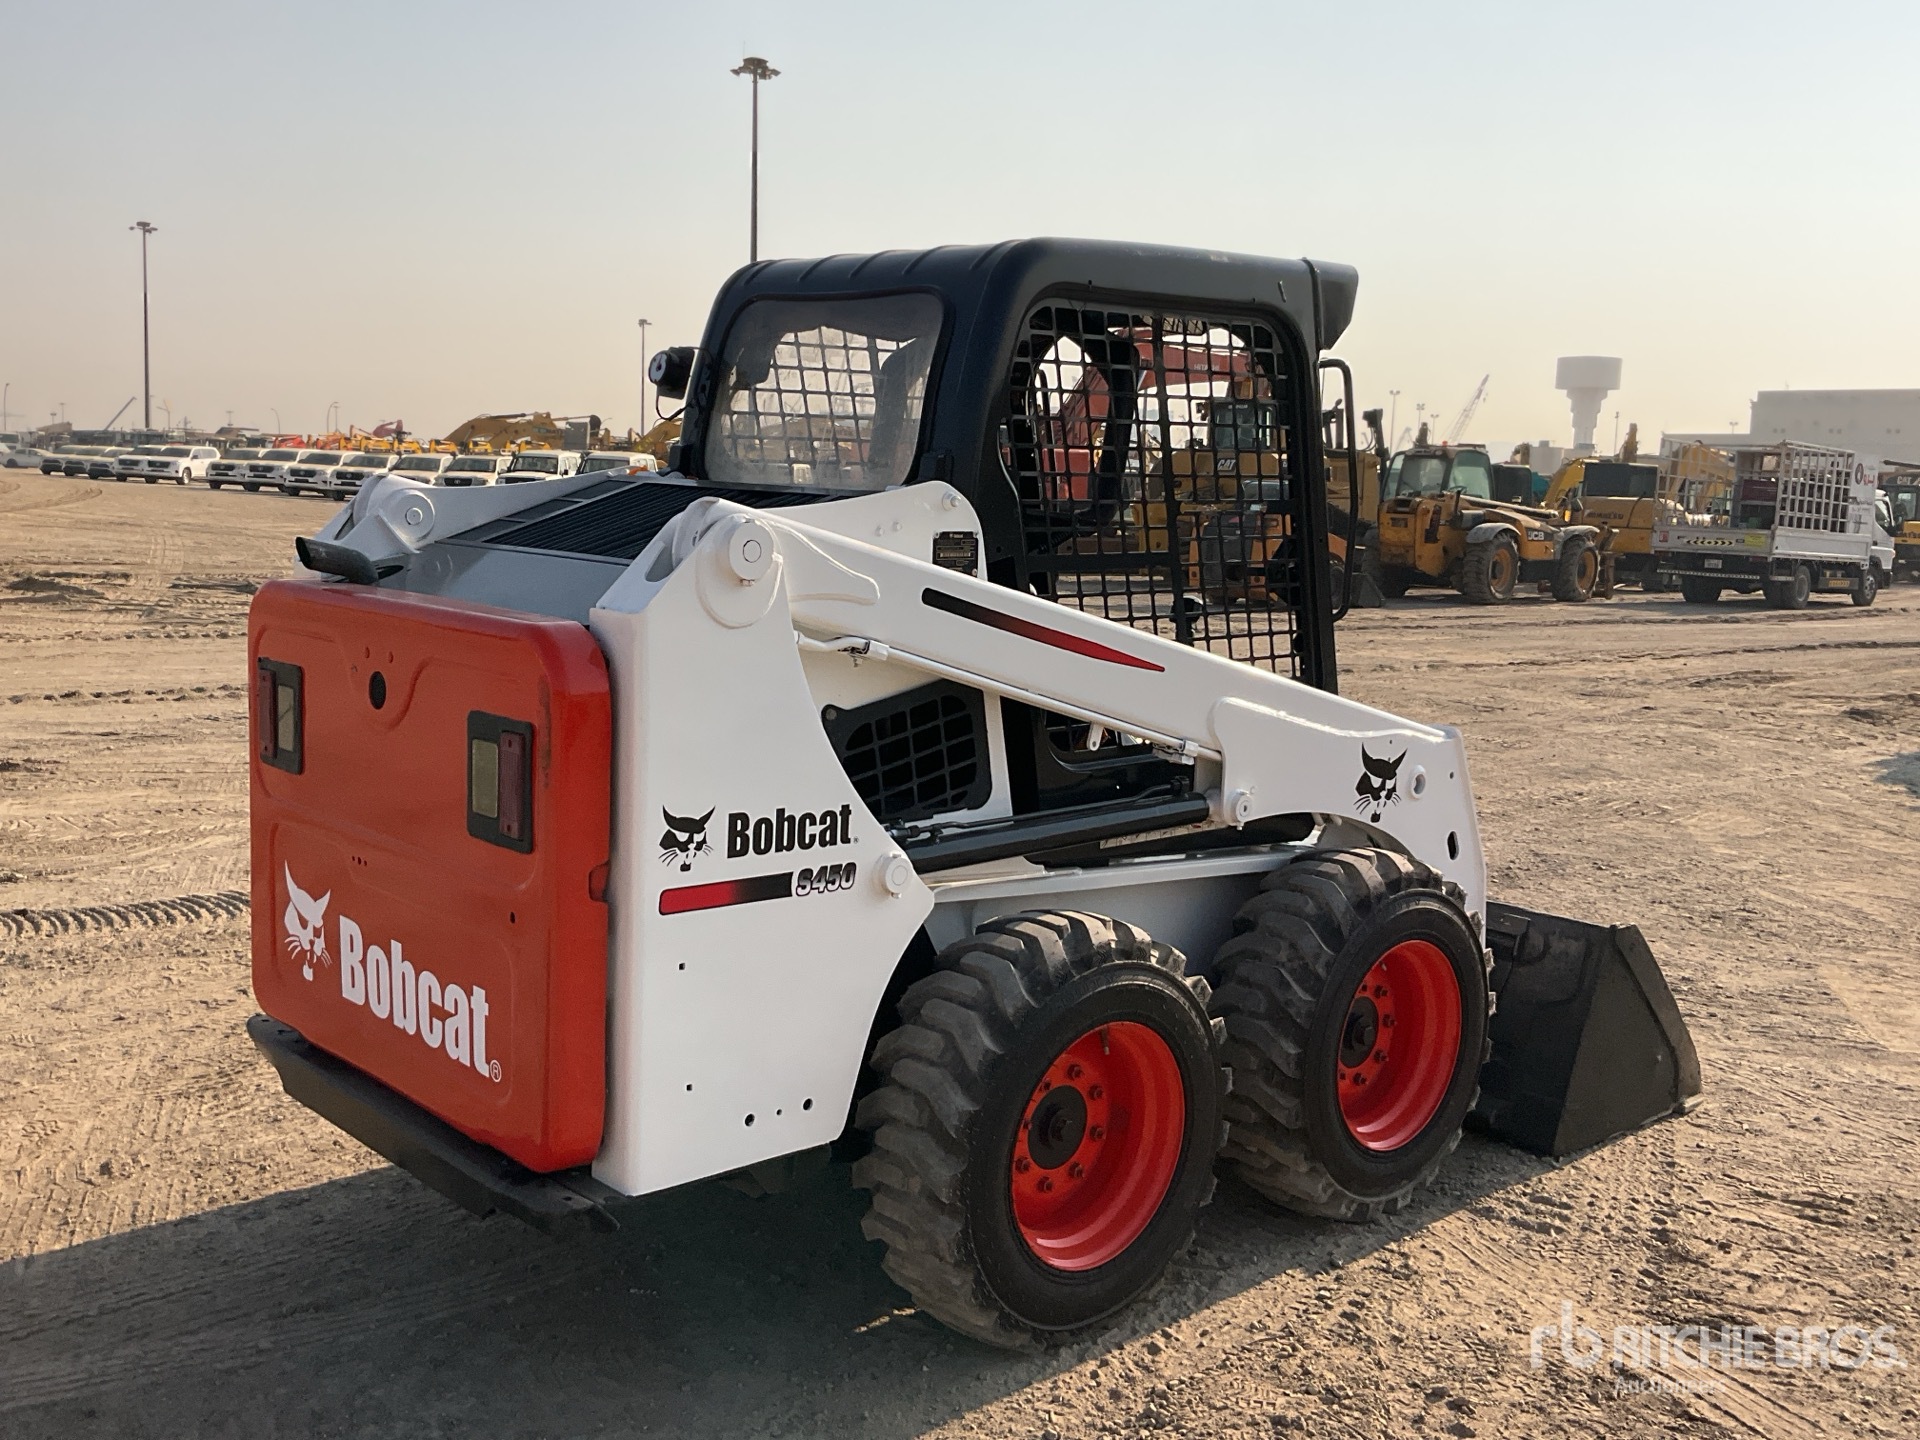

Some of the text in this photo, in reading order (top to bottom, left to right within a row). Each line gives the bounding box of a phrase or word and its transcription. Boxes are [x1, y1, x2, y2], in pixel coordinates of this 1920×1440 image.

[1216, 459, 1236, 471] CAT
[1528, 531, 1545, 541] JCB
[726, 803, 852, 859] Bobcat
[795, 861, 857, 897] S450
[339, 914, 490, 1078] Bobcat
